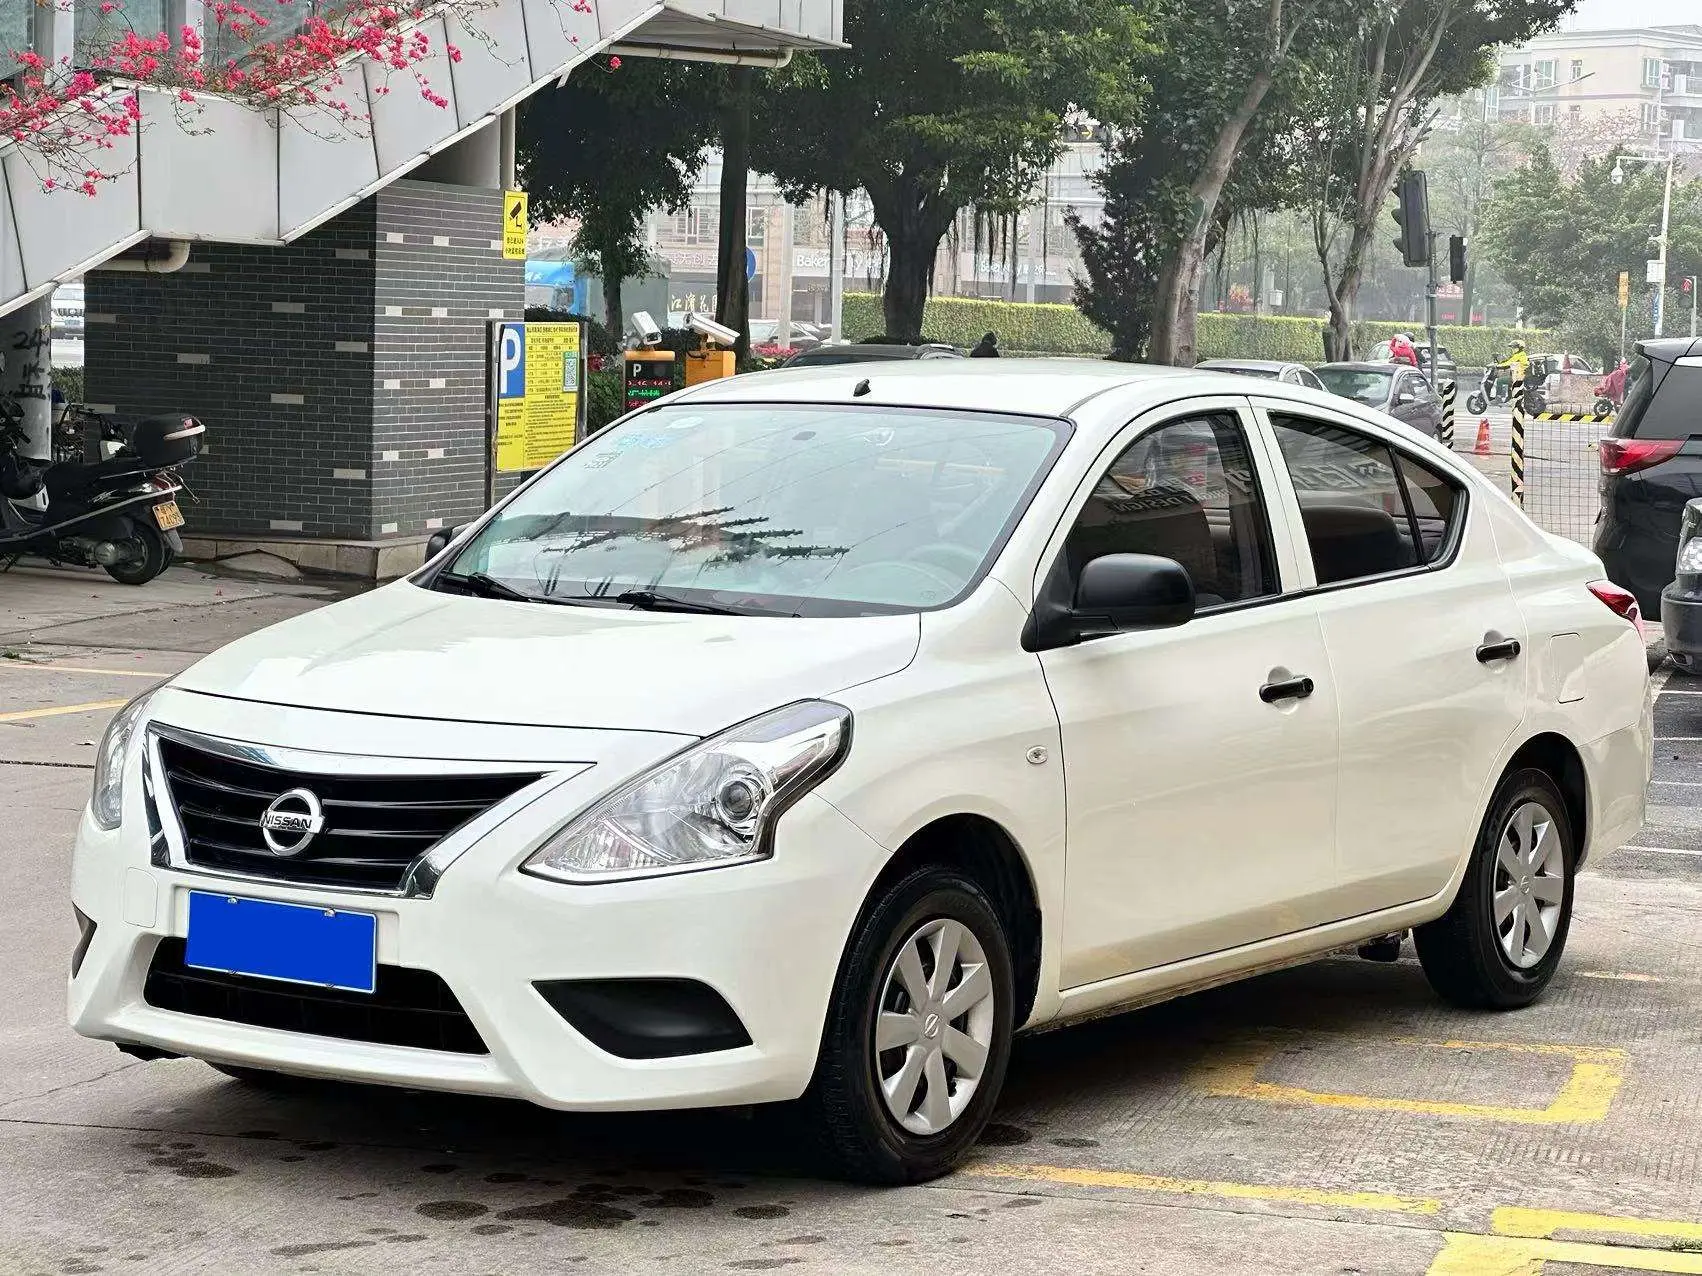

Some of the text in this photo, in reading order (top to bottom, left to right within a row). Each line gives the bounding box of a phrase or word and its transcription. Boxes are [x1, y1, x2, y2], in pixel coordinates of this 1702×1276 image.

[500, 328, 522, 394] P
[633, 363, 642, 378] P
[262, 813, 312, 829] NISSAN
